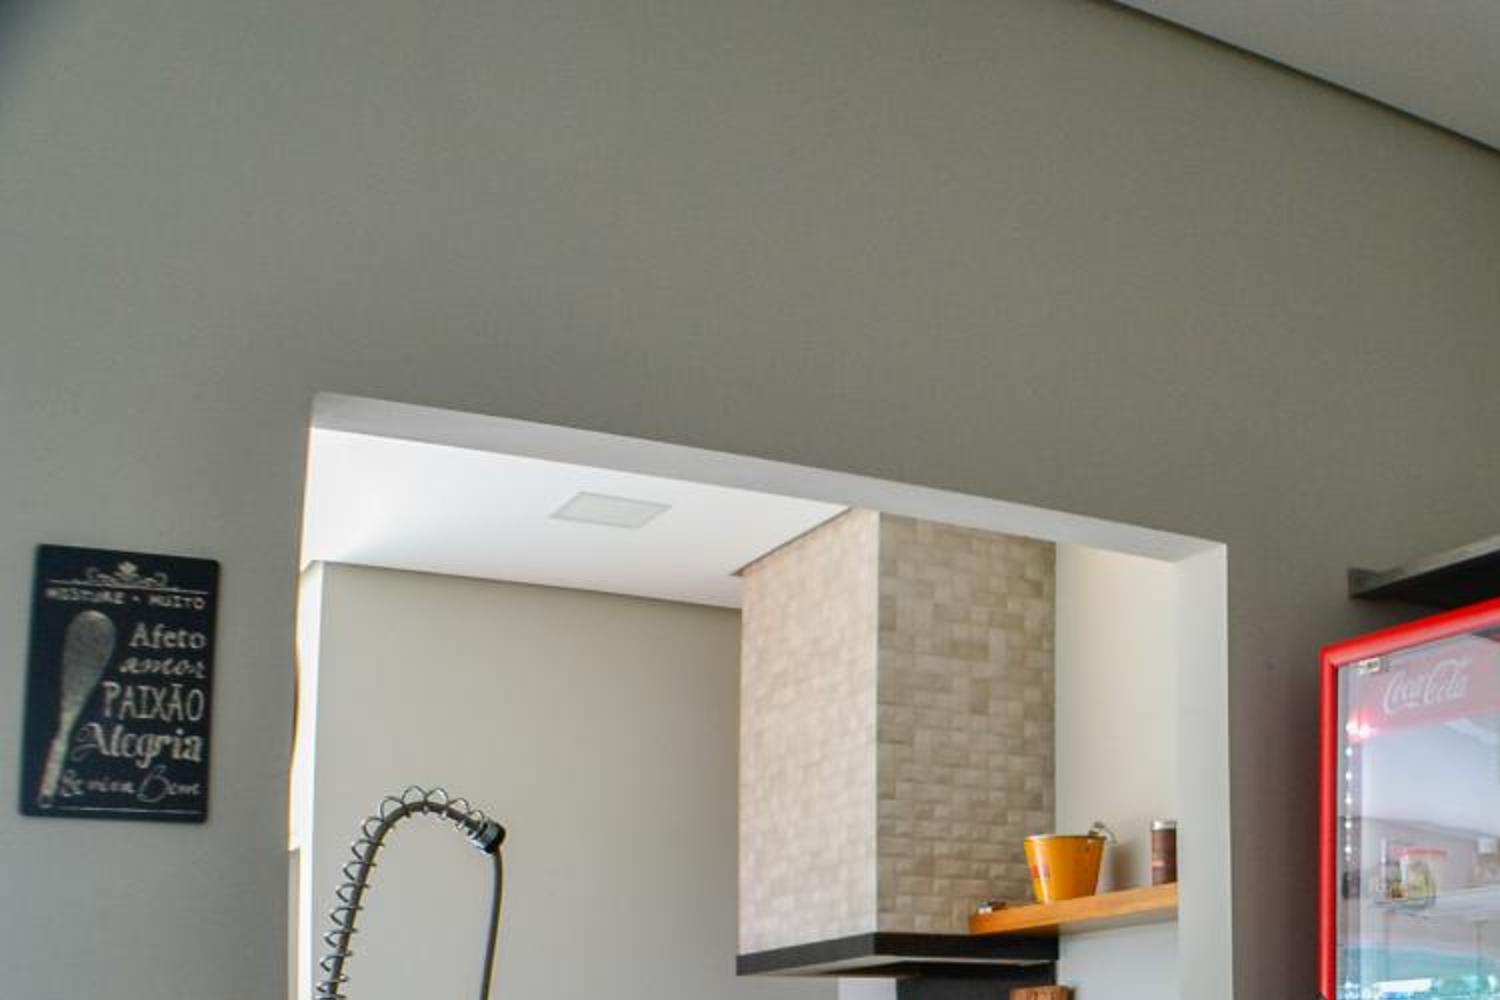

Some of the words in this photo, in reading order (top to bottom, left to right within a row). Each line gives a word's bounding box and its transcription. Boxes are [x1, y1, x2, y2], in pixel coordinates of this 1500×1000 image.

[128, 623, 206, 650] Afeto
[103, 680, 205, 722] PAIXÃO
[70, 722, 202, 769] Alegria
